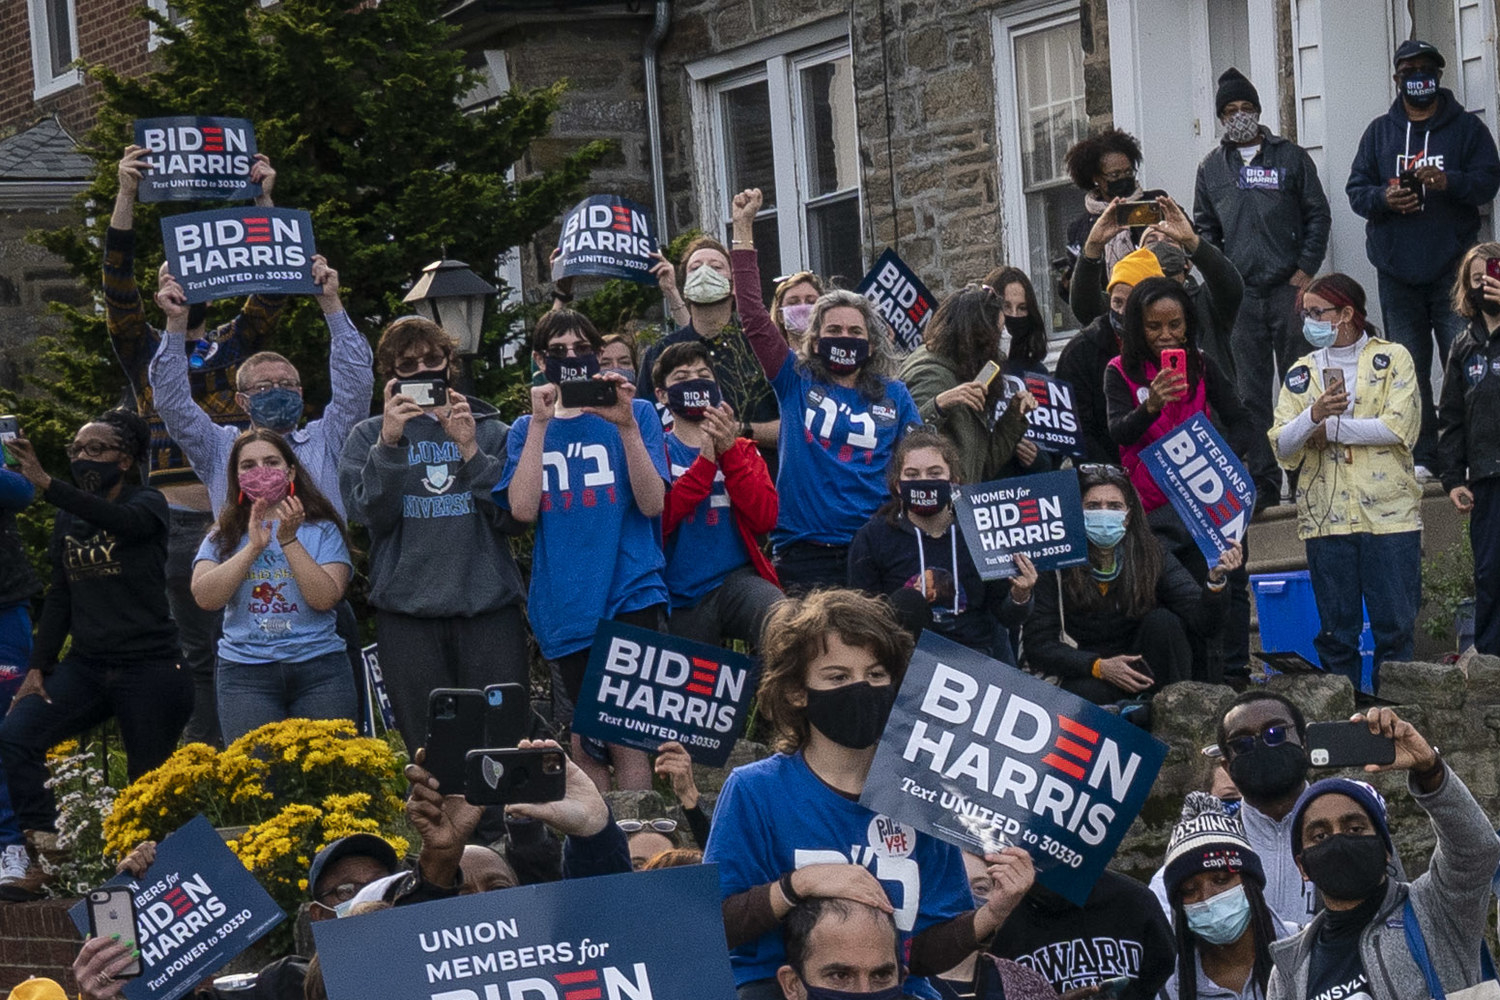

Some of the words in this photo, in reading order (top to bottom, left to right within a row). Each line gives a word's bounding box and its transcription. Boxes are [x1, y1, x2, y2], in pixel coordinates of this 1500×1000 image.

[144, 126, 248, 153] BIDEN
[147, 154, 250, 176] HARRIS
[169, 179, 208, 188] UNITED
[217, 179, 247, 188] 30330
[174, 217, 302, 253] BIDEN
[564, 205, 649, 238] BIDEN
[178, 245, 307, 277] HARRIS
[561, 231, 650, 258] HARRIS
[578, 254, 615, 265] UNITED
[624, 259, 649, 270] 30330
[187, 280, 207, 290] Text
[208, 273, 253, 286] UNITED
[255, 272, 265, 280] to
[266, 271, 303, 280] 30330
[1003, 374, 1073, 410] DEN
[408, 441, 463, 466] LUMB
[1046, 432, 1076, 445] 30330
[1191, 420, 1247, 494] VETERANS
[970, 489, 1015, 505] WOMEN
[1015, 486, 1031, 502] for
[1161, 429, 1249, 542] BIDEN
[972, 495, 1063, 531] BIDEN
[1165, 467, 1203, 519] VETERANS
[1206, 525, 1227, 554] 3033
[979, 520, 1067, 552] HARRIS
[1042, 543, 1072, 557] 30330
[604, 636, 747, 702] BIDEN
[597, 675, 737, 734] HARRIS
[598, 711, 624, 726] Text
[624, 717, 678, 740] UNITED
[679, 733, 689, 744] to
[689, 734, 721, 750] 30330
[920, 662, 1142, 804] BIDEN
[902, 719, 1116, 846] HARRIS
[900, 777, 938, 804] Text
[939, 792, 1021, 837] UNITED
[1022, 828, 1037, 845] to
[1039, 836, 1083, 868] 30330
[166, 872, 180, 890] for
[138, 873, 212, 945] BIDEN
[142, 896, 227, 967] HARRIS
[418, 918, 519, 953] UNION
[147, 972, 168, 992] Text
[166, 943, 209, 978] POWER
[207, 936, 219, 948] to
[218, 909, 252, 940] 30330
[426, 943, 574, 984] MEMBERS
[578, 938, 609, 965] for
